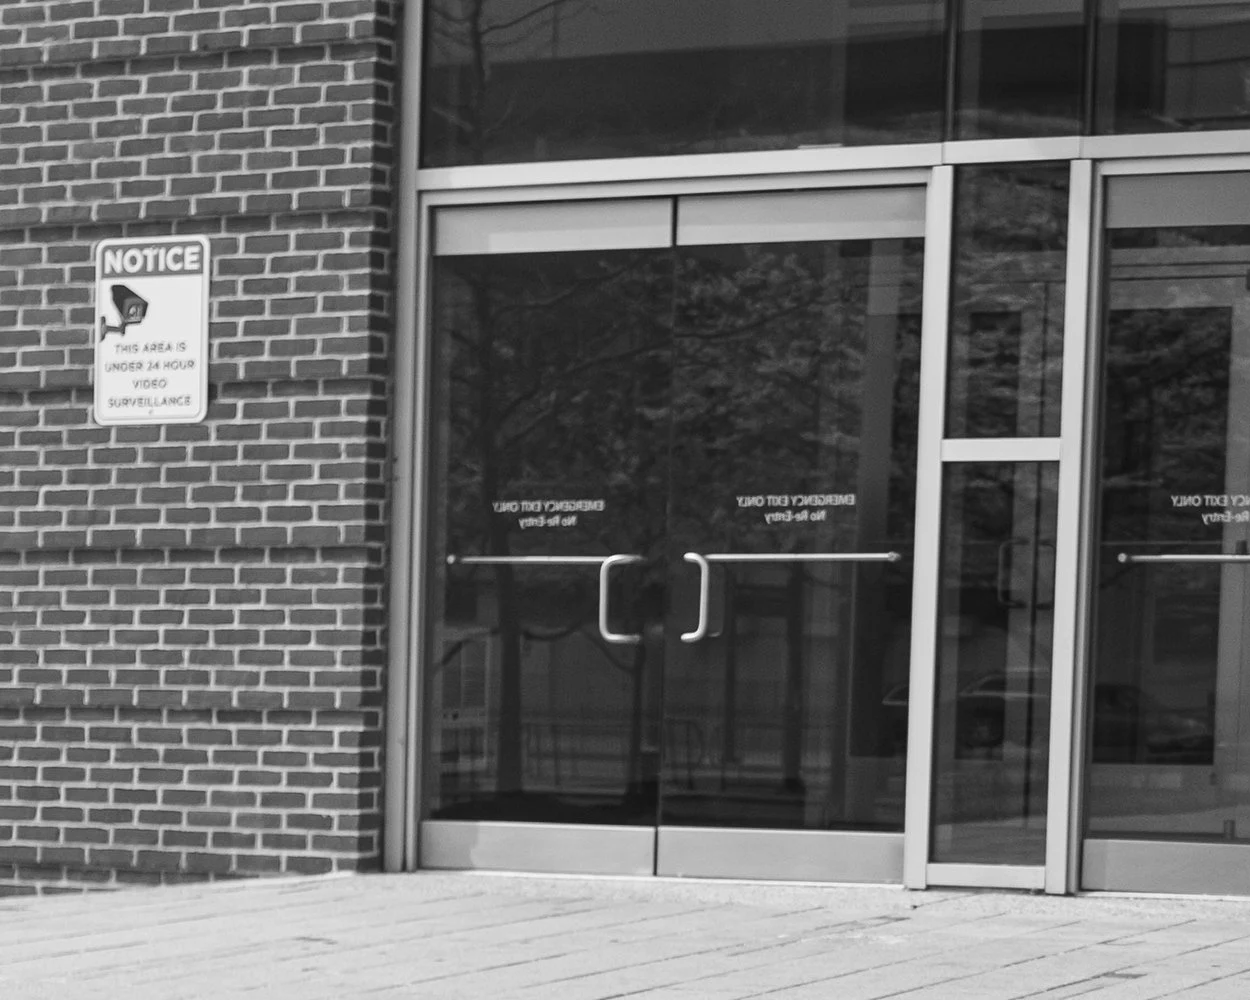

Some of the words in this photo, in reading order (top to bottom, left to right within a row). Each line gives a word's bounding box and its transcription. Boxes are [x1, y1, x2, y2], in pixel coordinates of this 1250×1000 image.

[104, 245, 201, 275] NOTICE
[114, 342, 138, 354] THIS
[143, 341, 172, 353] AREA
[176, 341, 187, 353] IS
[105, 361, 143, 373] UNDER
[147, 360, 160, 371] 24
[163, 359, 195, 371] HOUR
[132, 378, 167, 390] VIDEO
[108, 396, 191, 408] SURVEILLANCE
